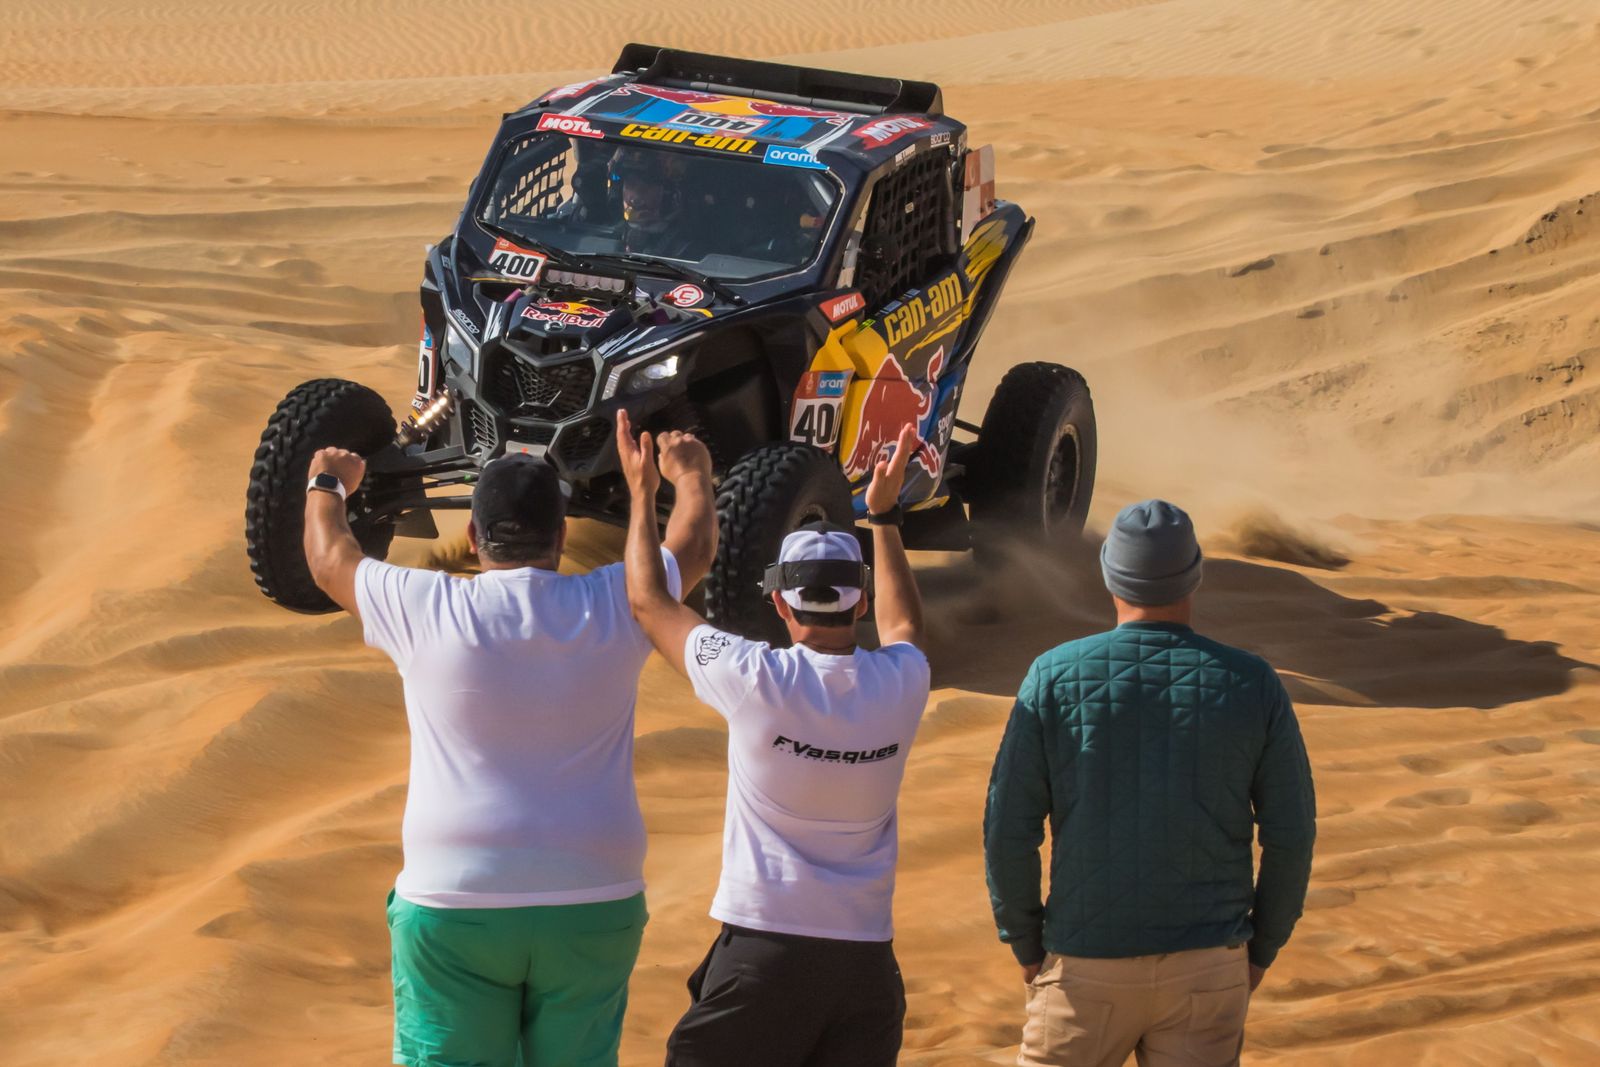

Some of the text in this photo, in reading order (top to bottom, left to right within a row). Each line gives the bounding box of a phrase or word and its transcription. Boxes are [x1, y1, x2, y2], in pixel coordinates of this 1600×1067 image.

[676, 112, 756, 131] 400
[491, 253, 539, 277] 400
[521, 306, 607, 328] Red Bull
[832, 295, 859, 318] MOTUL
